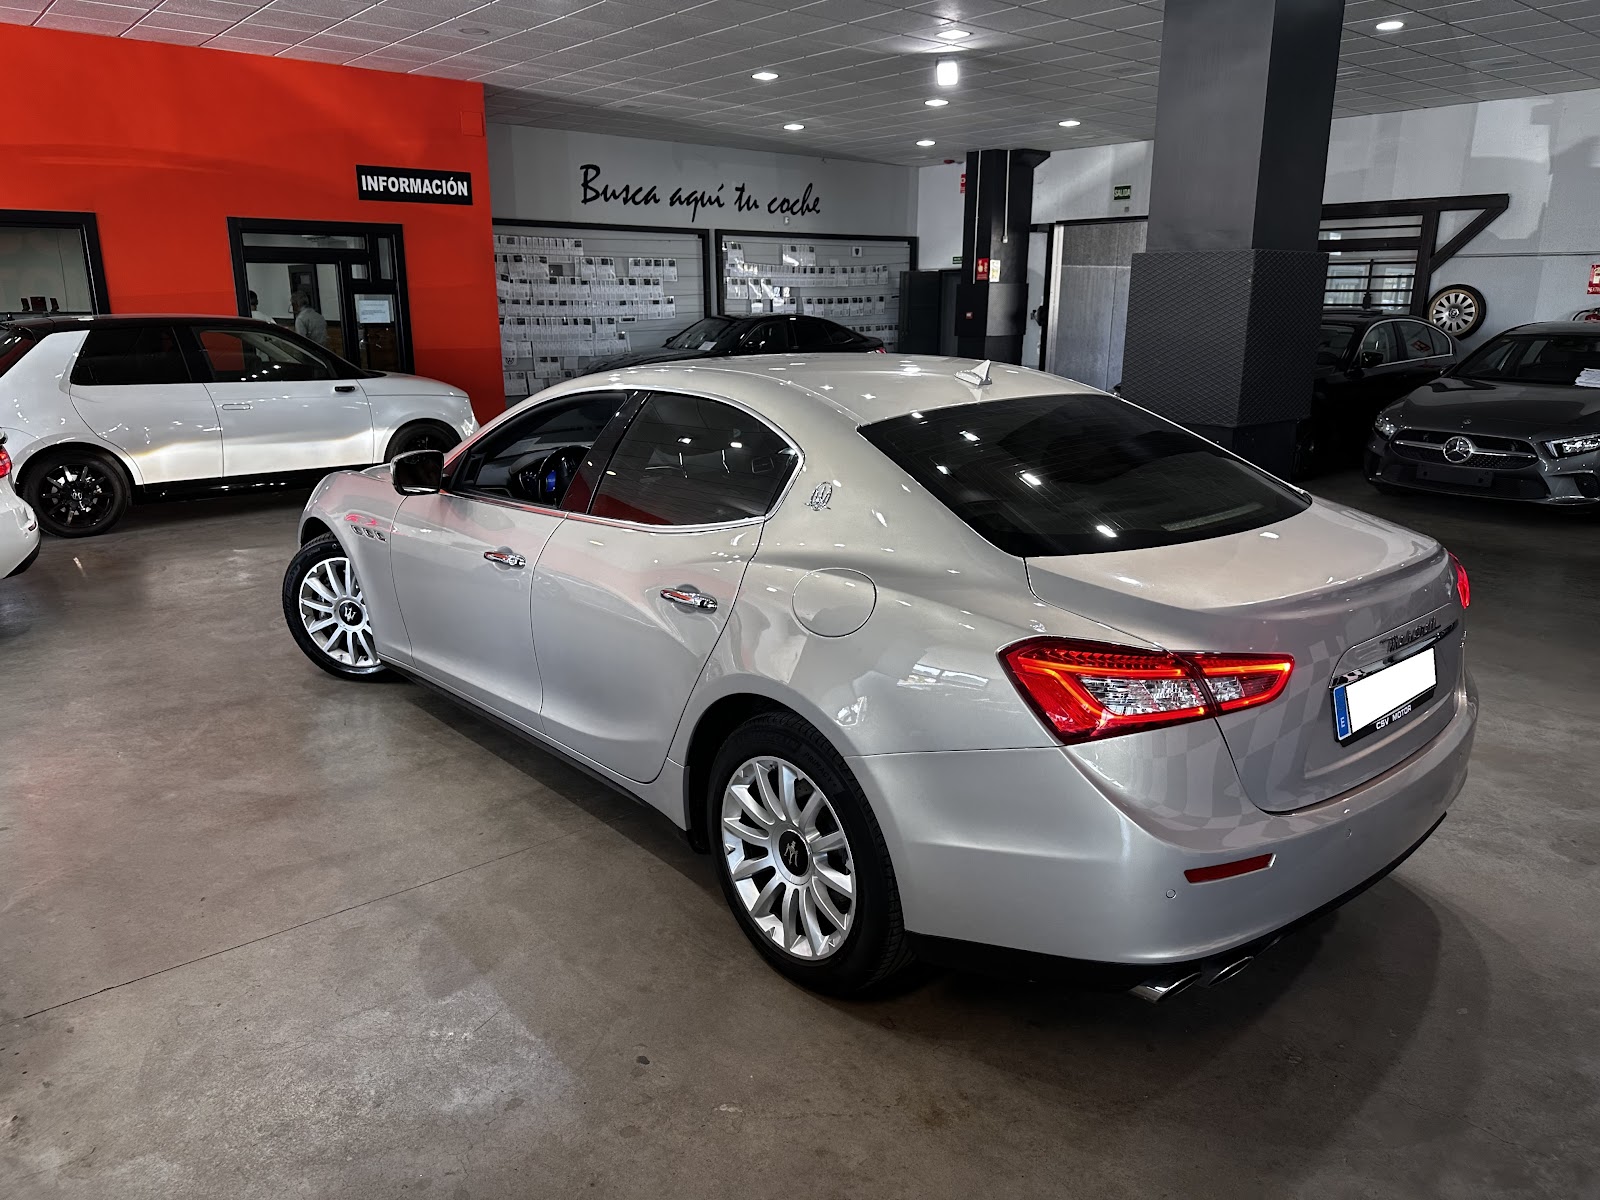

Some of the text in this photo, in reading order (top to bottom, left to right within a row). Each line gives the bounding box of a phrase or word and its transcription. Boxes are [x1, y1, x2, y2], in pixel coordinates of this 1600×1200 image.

[361, 174, 468, 197] INFORMACIÓN
[579, 163, 821, 223] Busca aquí tu coche
[1340, 716, 1346, 728] E
[1391, 704, 1412, 722] MOTOR
